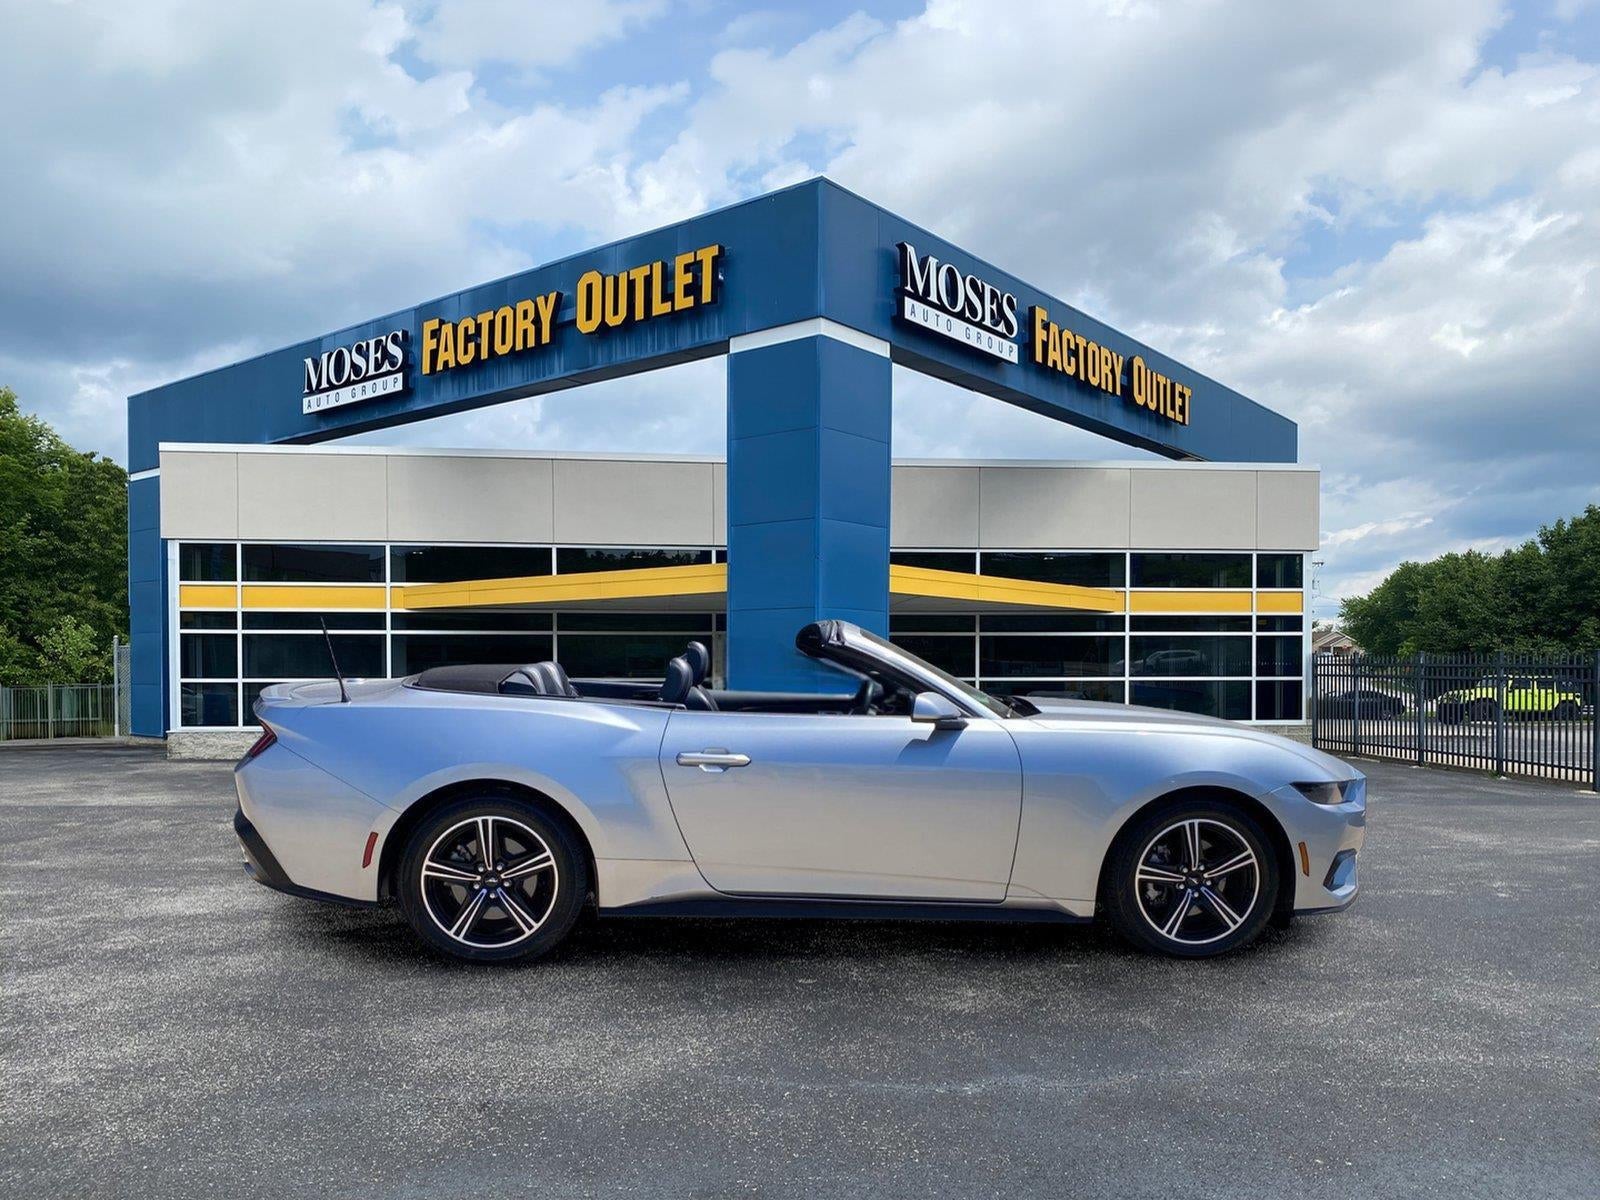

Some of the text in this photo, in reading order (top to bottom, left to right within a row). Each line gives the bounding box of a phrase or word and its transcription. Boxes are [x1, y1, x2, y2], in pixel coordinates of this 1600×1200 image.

[422, 244, 720, 376] FACTORY OUTLET
[904, 242, 1018, 338] MOSES
[303, 331, 404, 394] MOSES
[910, 303, 1015, 358] AUTO GROUP
[1033, 305, 1192, 426] FACTORY OUTLET
[306, 376, 399, 410] AUTO GROUP
